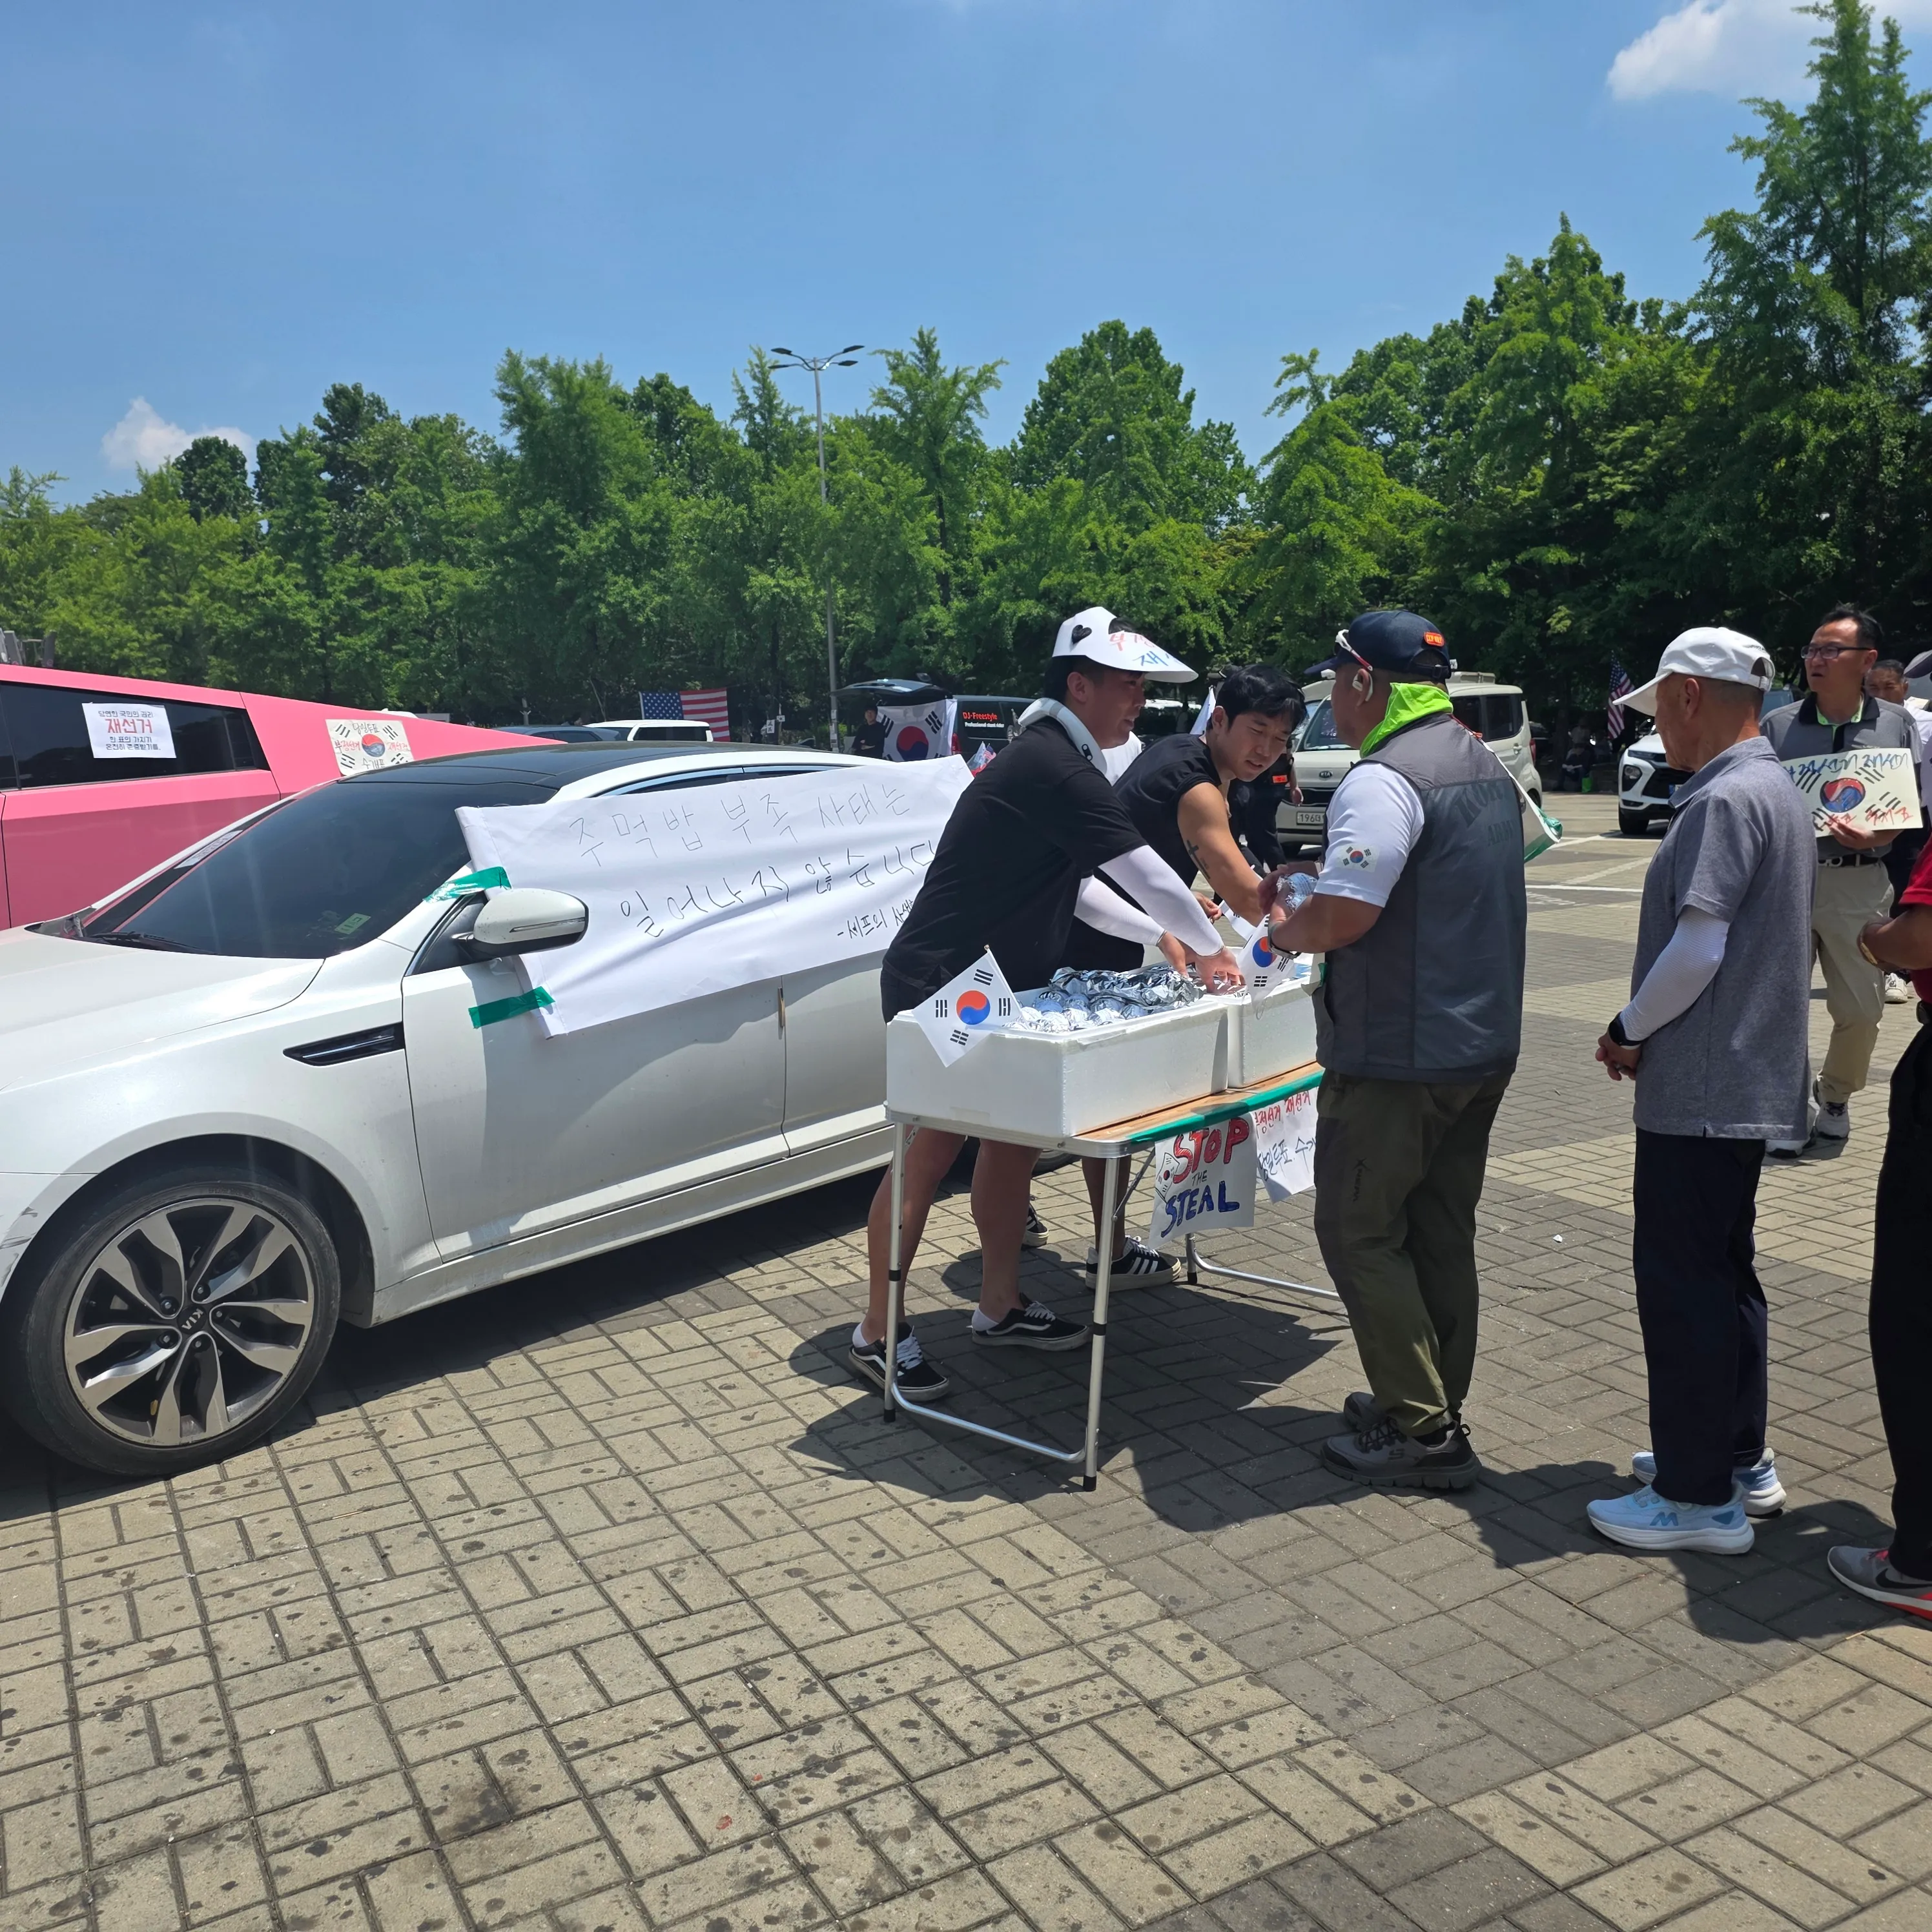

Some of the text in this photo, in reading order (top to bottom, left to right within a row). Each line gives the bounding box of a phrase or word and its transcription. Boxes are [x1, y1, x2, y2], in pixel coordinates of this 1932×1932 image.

[105, 718, 152, 734] 재선거
[334, 739, 408, 754] 부정선거 재선거
[569, 784, 910, 867] 주먹밥 부족 사태는
[620, 866, 790, 938] 일어나지
[1284, 1090, 1311, 1115] 재선거
[1173, 1117, 1249, 1184] STOP
[1192, 1169, 1208, 1186] THE
[1160, 1180, 1240, 1238] STEAL
[181, 1308, 203, 1330] KIA
